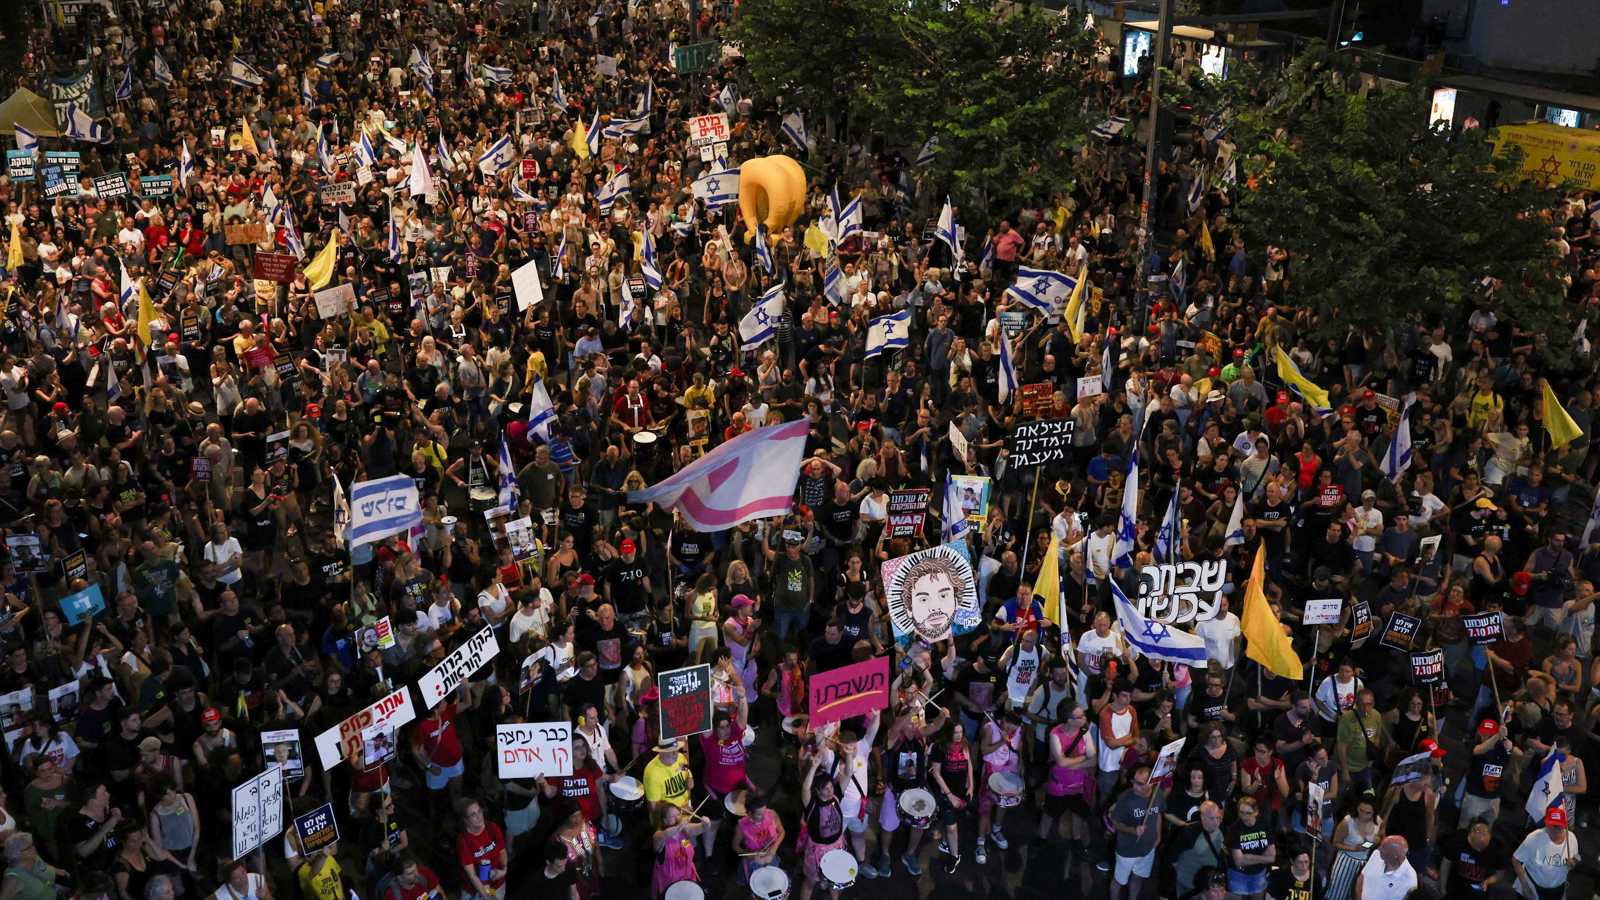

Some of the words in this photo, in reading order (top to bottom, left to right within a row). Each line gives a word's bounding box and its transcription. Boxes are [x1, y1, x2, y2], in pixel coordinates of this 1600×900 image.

[697, 115, 721, 129] מים
[1016, 434, 1073, 452] המדינה
[892, 494, 917, 504] שכחנו
[918, 493, 929, 502] לא
[890, 514, 923, 526] WAR
[620, 568, 644, 583] 7.10
[1138, 558, 1227, 597] שביתה
[1137, 590, 1223, 625] עכשיו
[1464, 617, 1489, 629] שכחנו
[1489, 614, 1500, 625] לא
[1468, 628, 1486, 639] 7.10
[1487, 625, 1500, 636] את
[435, 650, 463, 678] ברור
[1412, 655, 1435, 666] שכחנו
[1434, 652, 1442, 663] לא
[1414, 665, 1432, 676] 7.10
[815, 672, 885, 705] תשבתו
[498, 730, 533, 745] נחצה
[539, 727, 568, 742] כבר
[504, 747, 543, 764] אדום
[563, 777, 587, 787] מדינה
[665, 771, 688, 796] NOW
[562, 788, 590, 798] חטופה
[307, 821, 327, 835] ילדים
